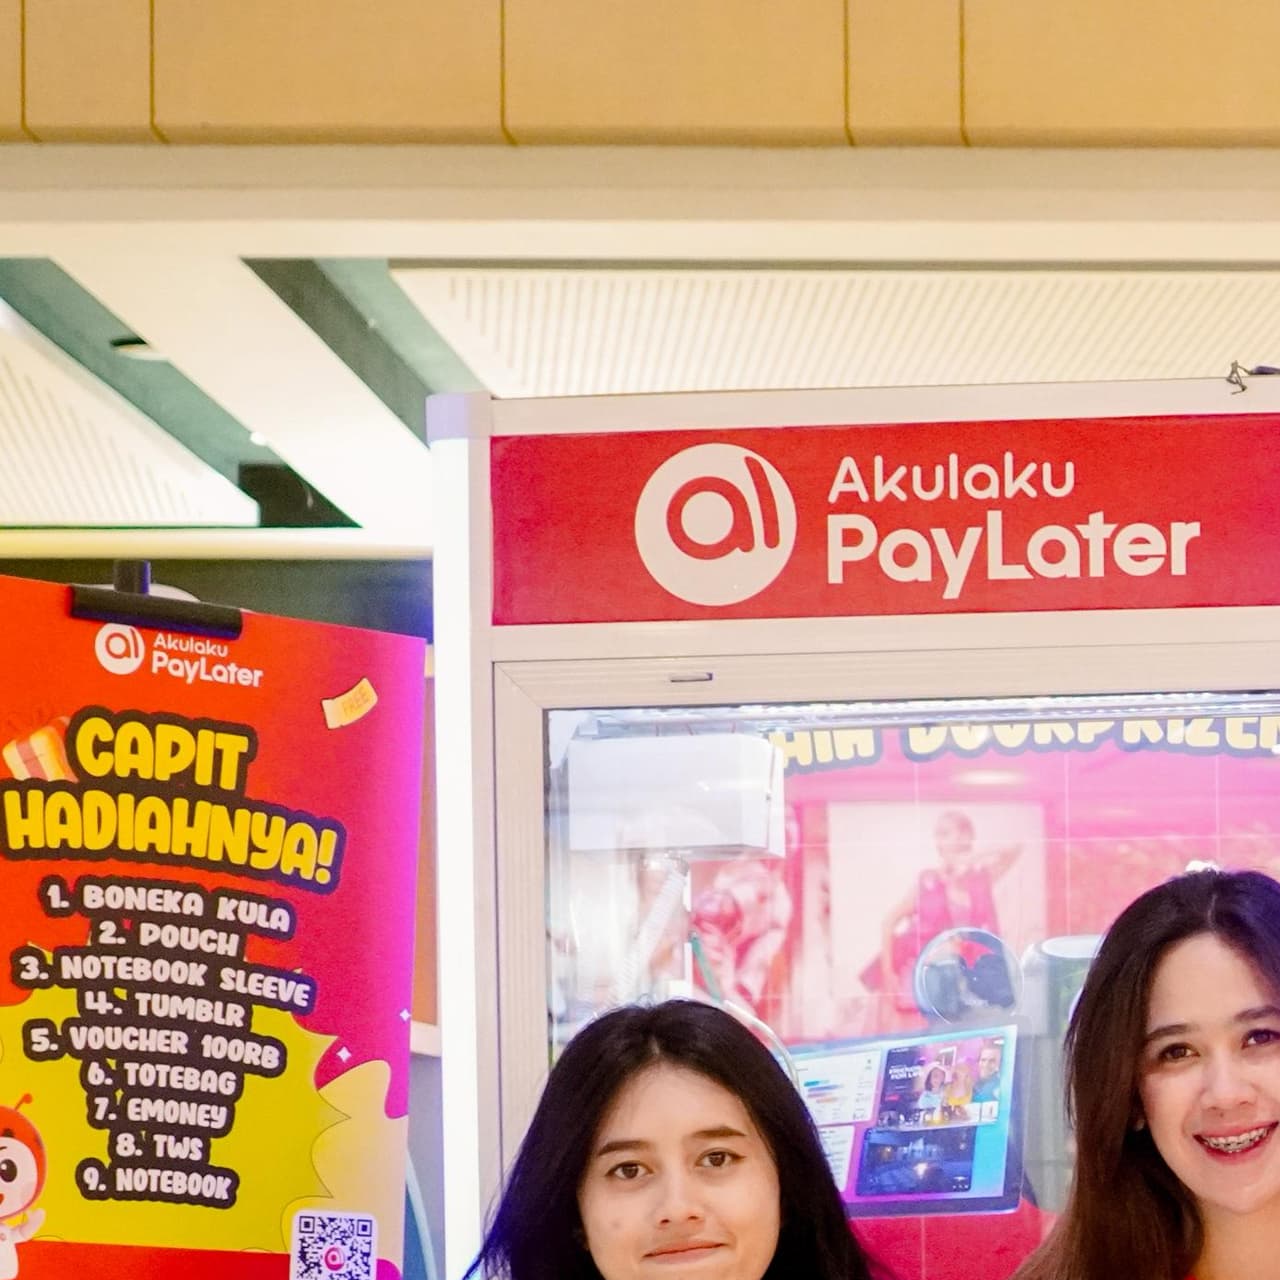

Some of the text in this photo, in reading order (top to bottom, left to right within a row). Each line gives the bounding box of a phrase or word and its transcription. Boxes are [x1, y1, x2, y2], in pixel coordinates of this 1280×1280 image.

[828, 451, 1077, 505] Akulaku
[827, 510, 1201, 599] PayLater
[153, 633, 229, 658] Akulaku
[151, 656, 264, 688] PayLater
[76, 716, 249, 791] CAPIT
[3, 789, 338, 885] HADIAHNYA!
[47, 884, 291, 933] 1. BONEKA KULA
[99, 921, 240, 957] 2. POUCH
[19, 956, 312, 1008] 3. NOTEBOOK SLEEVE
[85, 991, 246, 1028] 4. TUMBLR
[30, 1026, 281, 1069] 5. VOUCHER 100RB
[87, 1062, 237, 1095] 6. TOTEBAG
[94, 1097, 227, 1130] 7. EMONEY
[116, 1133, 204, 1161] 8. TWS
[83, 1167, 233, 1201] 9. NOTEBOOK
